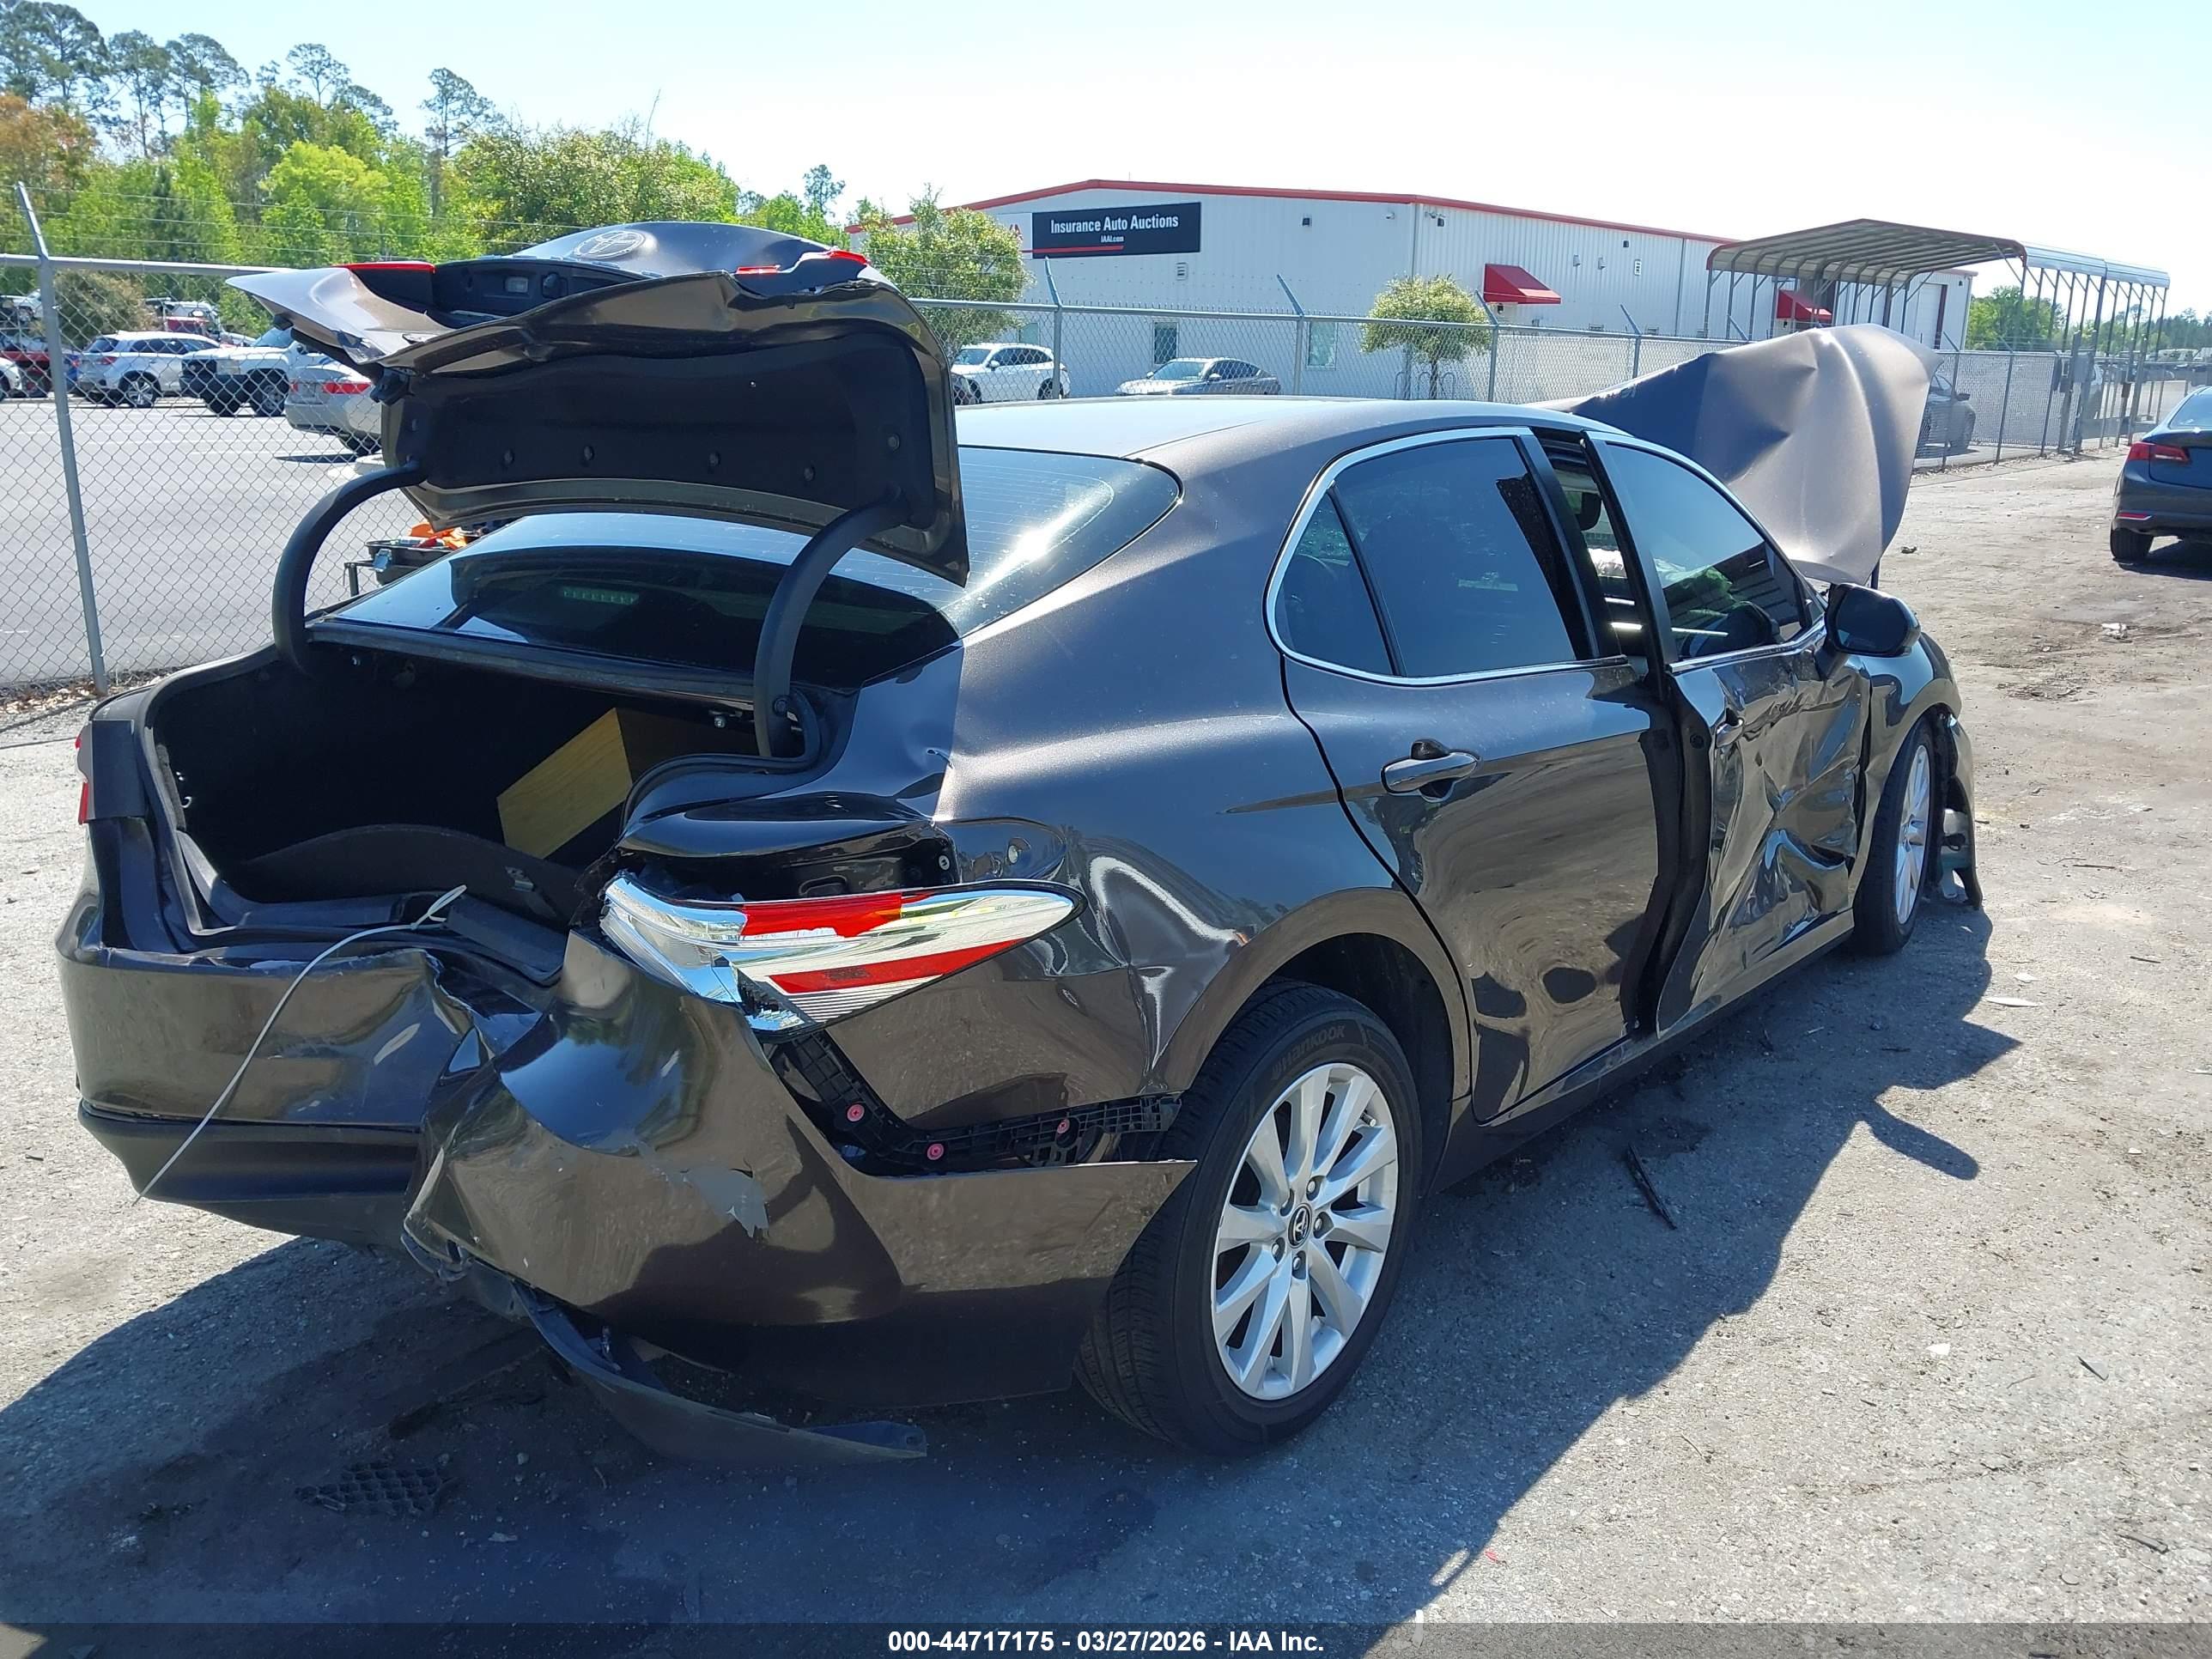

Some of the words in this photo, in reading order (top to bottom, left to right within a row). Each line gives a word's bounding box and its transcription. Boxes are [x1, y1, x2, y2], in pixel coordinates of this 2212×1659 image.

[1050, 220, 1101, 234] Insurance
[1103, 216, 1127, 231] Auto
[1130, 214, 1179, 229] Auctions
